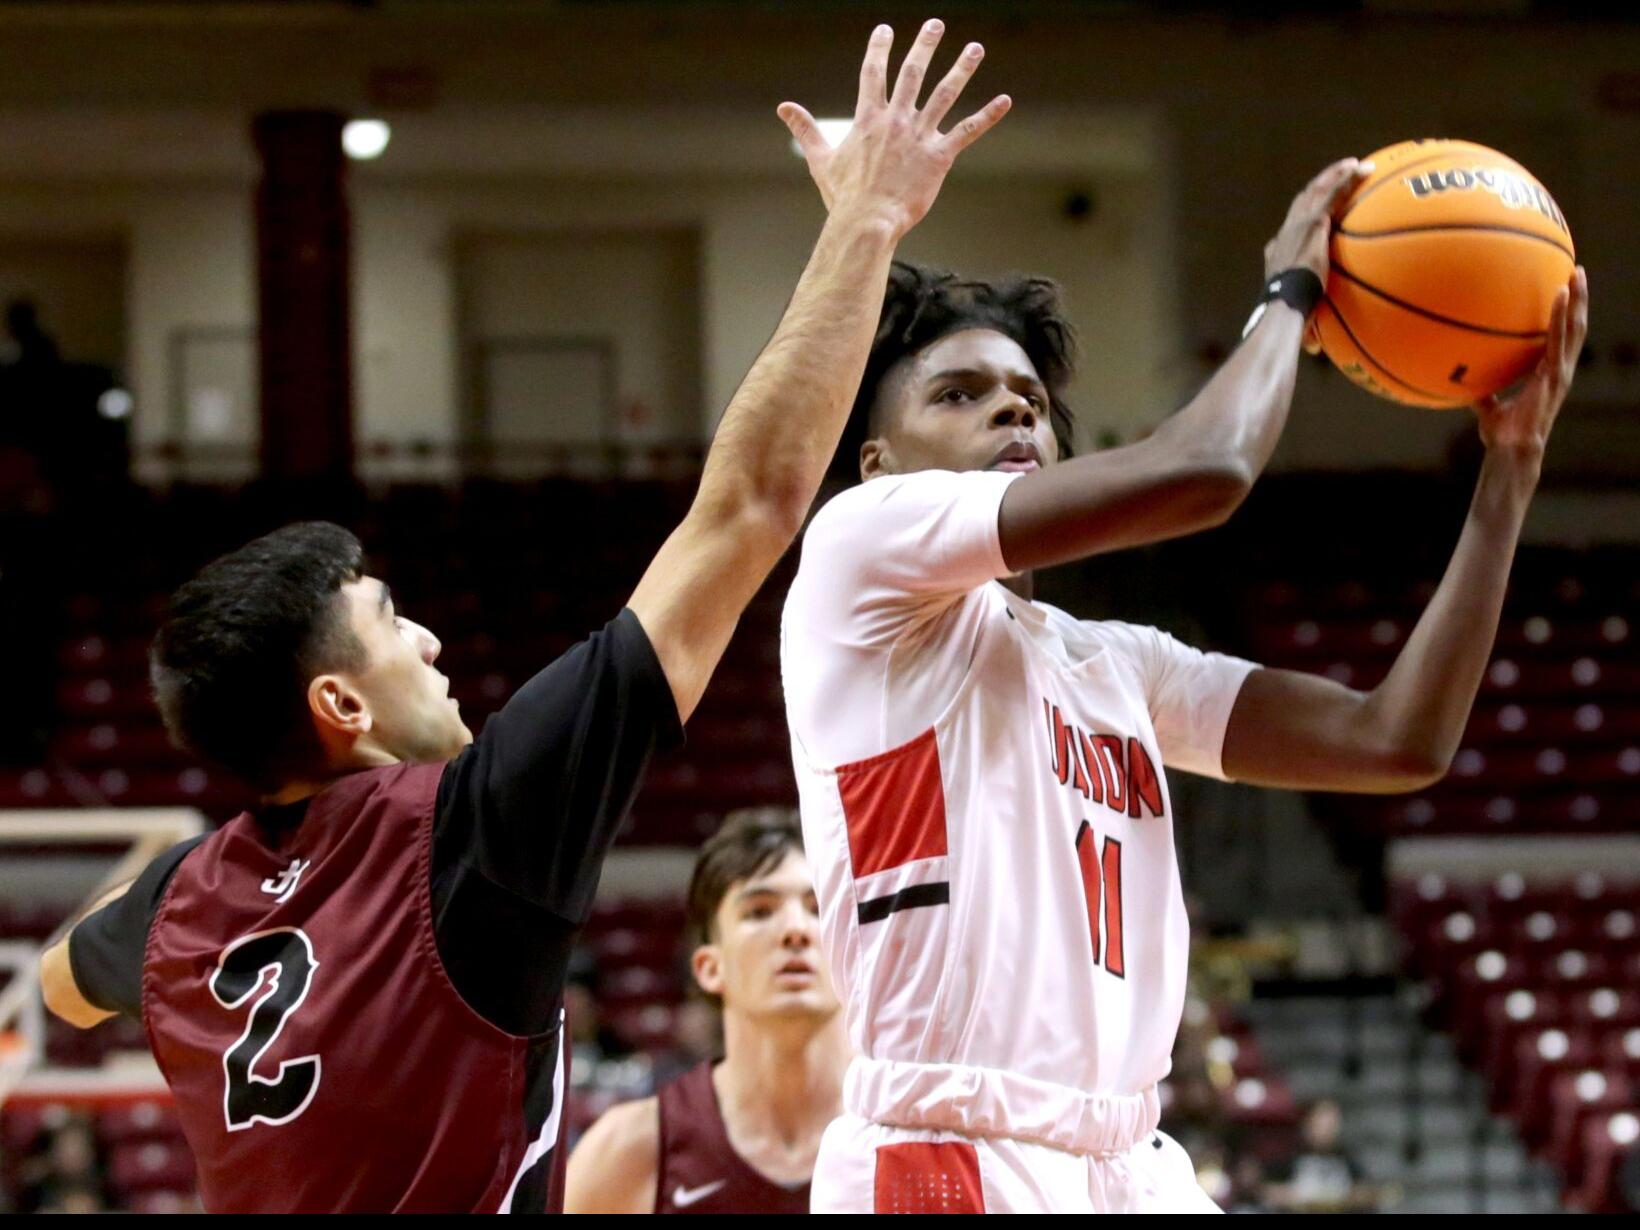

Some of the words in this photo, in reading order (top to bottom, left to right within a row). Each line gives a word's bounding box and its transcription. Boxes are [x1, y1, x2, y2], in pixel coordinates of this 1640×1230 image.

[1043, 697, 1164, 818] UNION
[1075, 819, 1125, 979] 11
[209, 925, 322, 1132] 2
